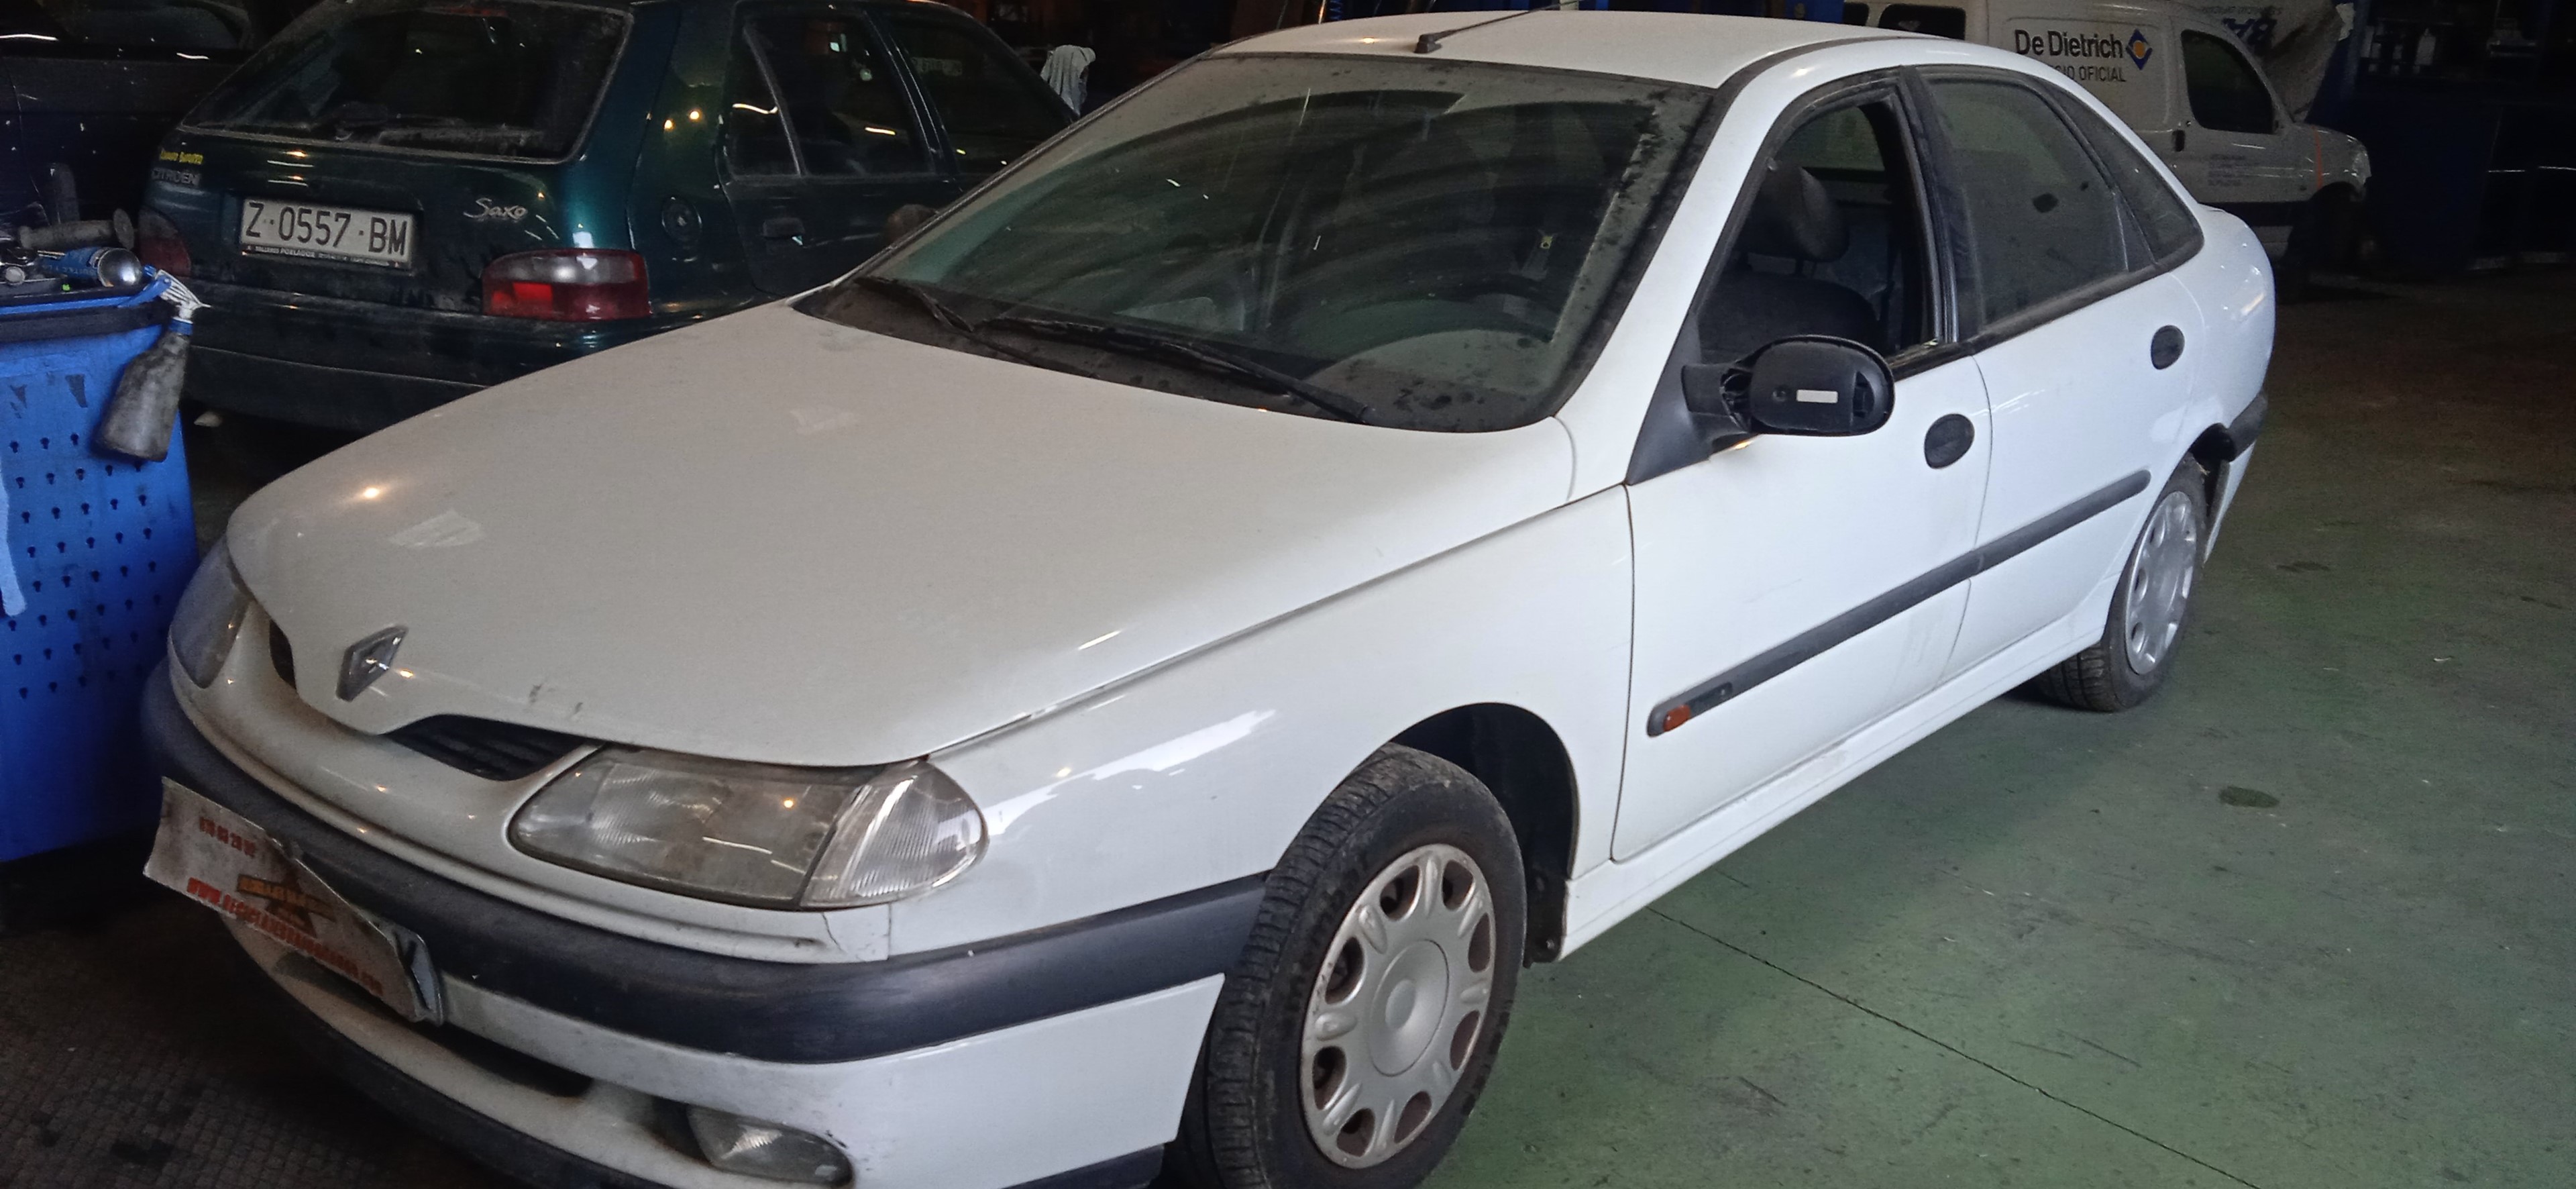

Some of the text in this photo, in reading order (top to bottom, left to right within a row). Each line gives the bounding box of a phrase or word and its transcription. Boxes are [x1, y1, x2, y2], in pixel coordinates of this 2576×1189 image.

[2015, 30, 2123, 58] De Dietrich
[2079, 66, 2127, 83] OFICIAL
[464, 198, 527, 221] Saxo
